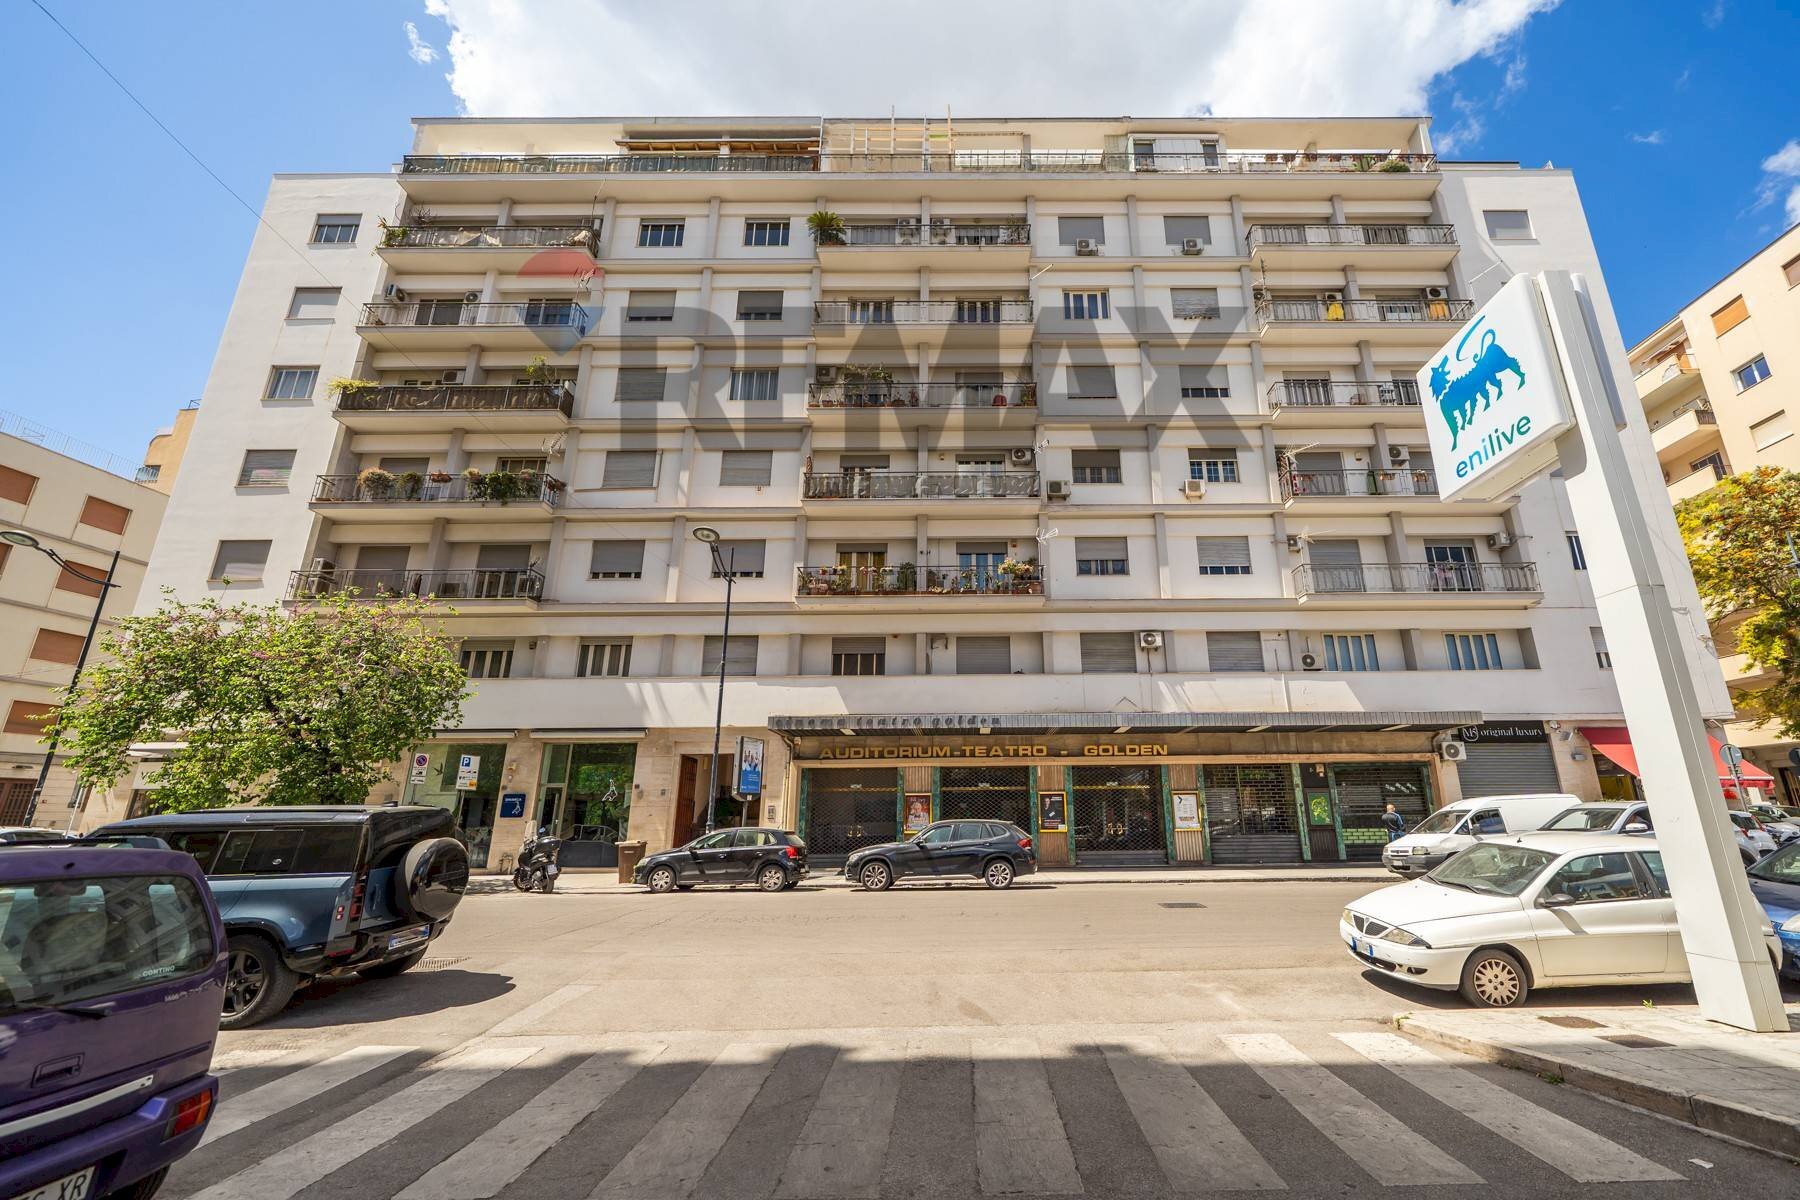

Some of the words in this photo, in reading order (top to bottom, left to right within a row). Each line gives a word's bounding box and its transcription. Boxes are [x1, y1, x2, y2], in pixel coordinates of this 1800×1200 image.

[1456, 415, 1531, 478] enilive
[931, 714, 1001, 728] golden
[1480, 727, 1513, 737] original
[1084, 744, 1168, 756] GOLDEN
